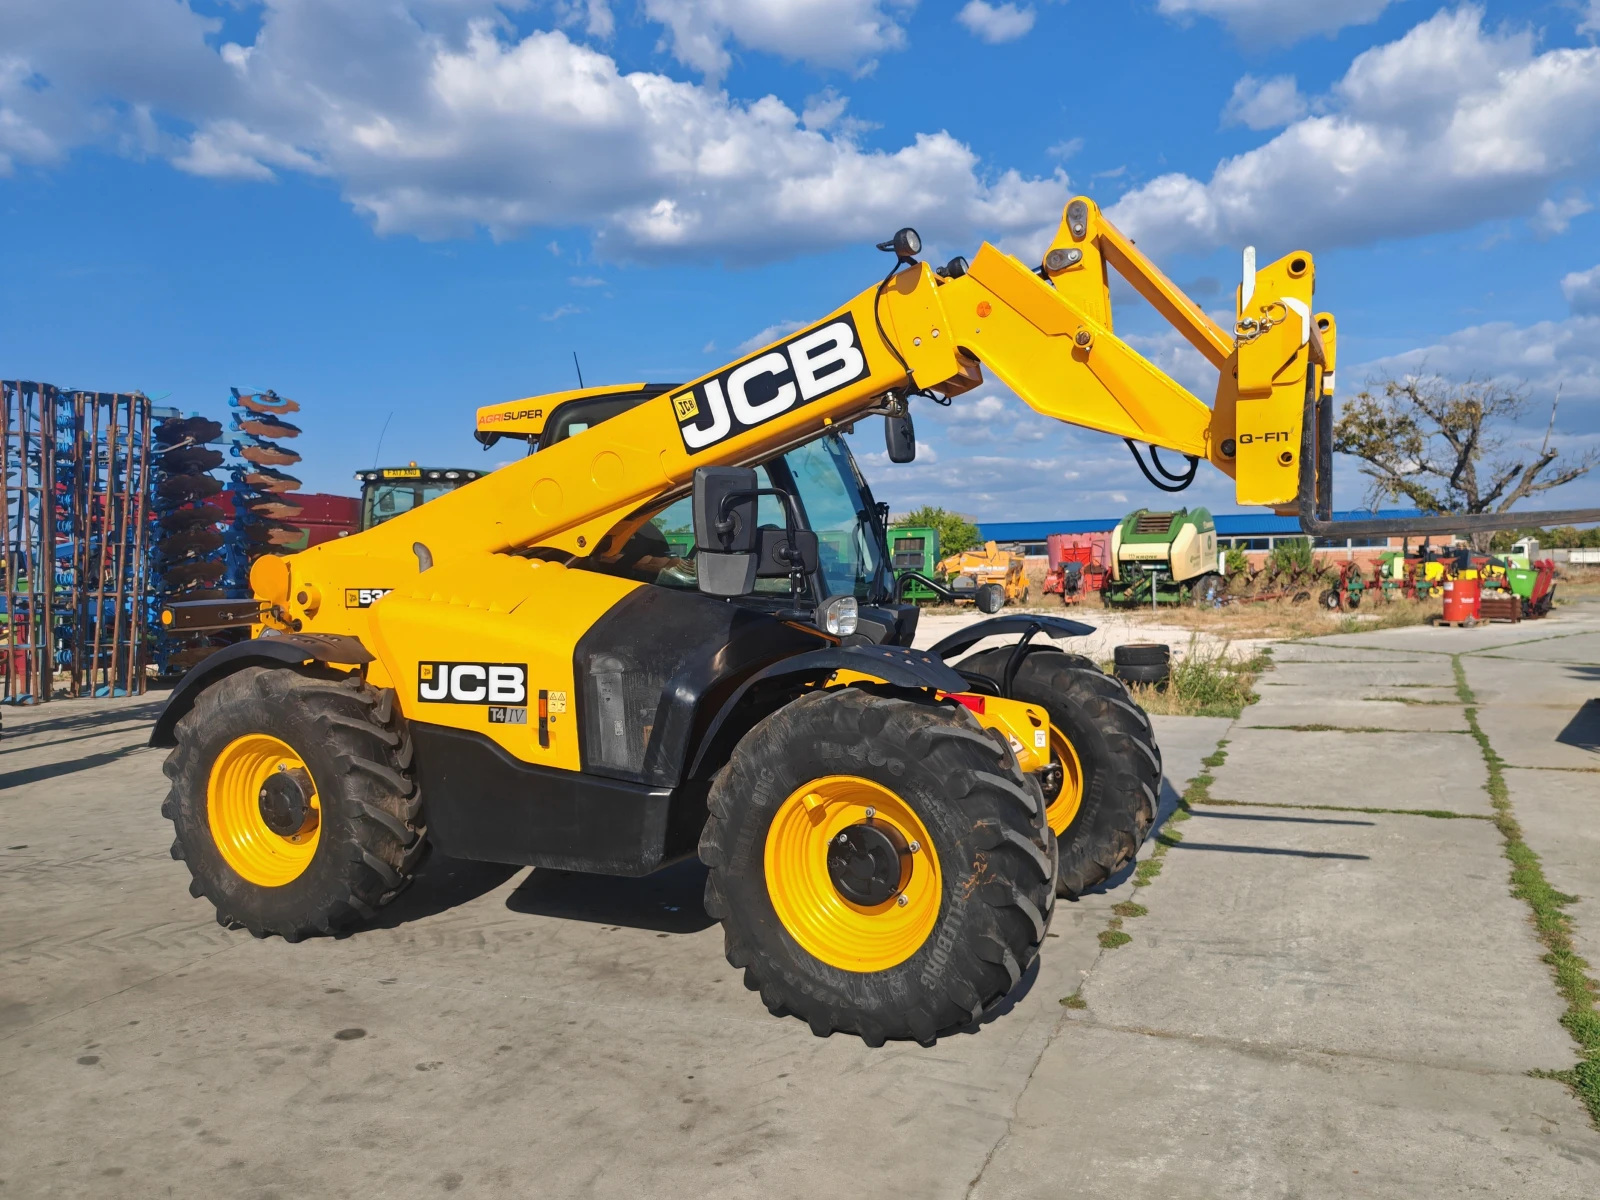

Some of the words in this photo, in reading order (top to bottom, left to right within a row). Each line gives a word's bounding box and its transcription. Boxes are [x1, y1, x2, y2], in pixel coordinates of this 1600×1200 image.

[682, 322, 864, 448] JCB
[678, 399, 696, 416] JCB
[478, 409, 542, 425] AGRISUPER
[360, 590, 391, 604] 53
[420, 664, 525, 702] JCB
[490, 708, 505, 722] T4
[508, 709, 525, 722] IV
[920, 870, 973, 990] TRELLEBORG
